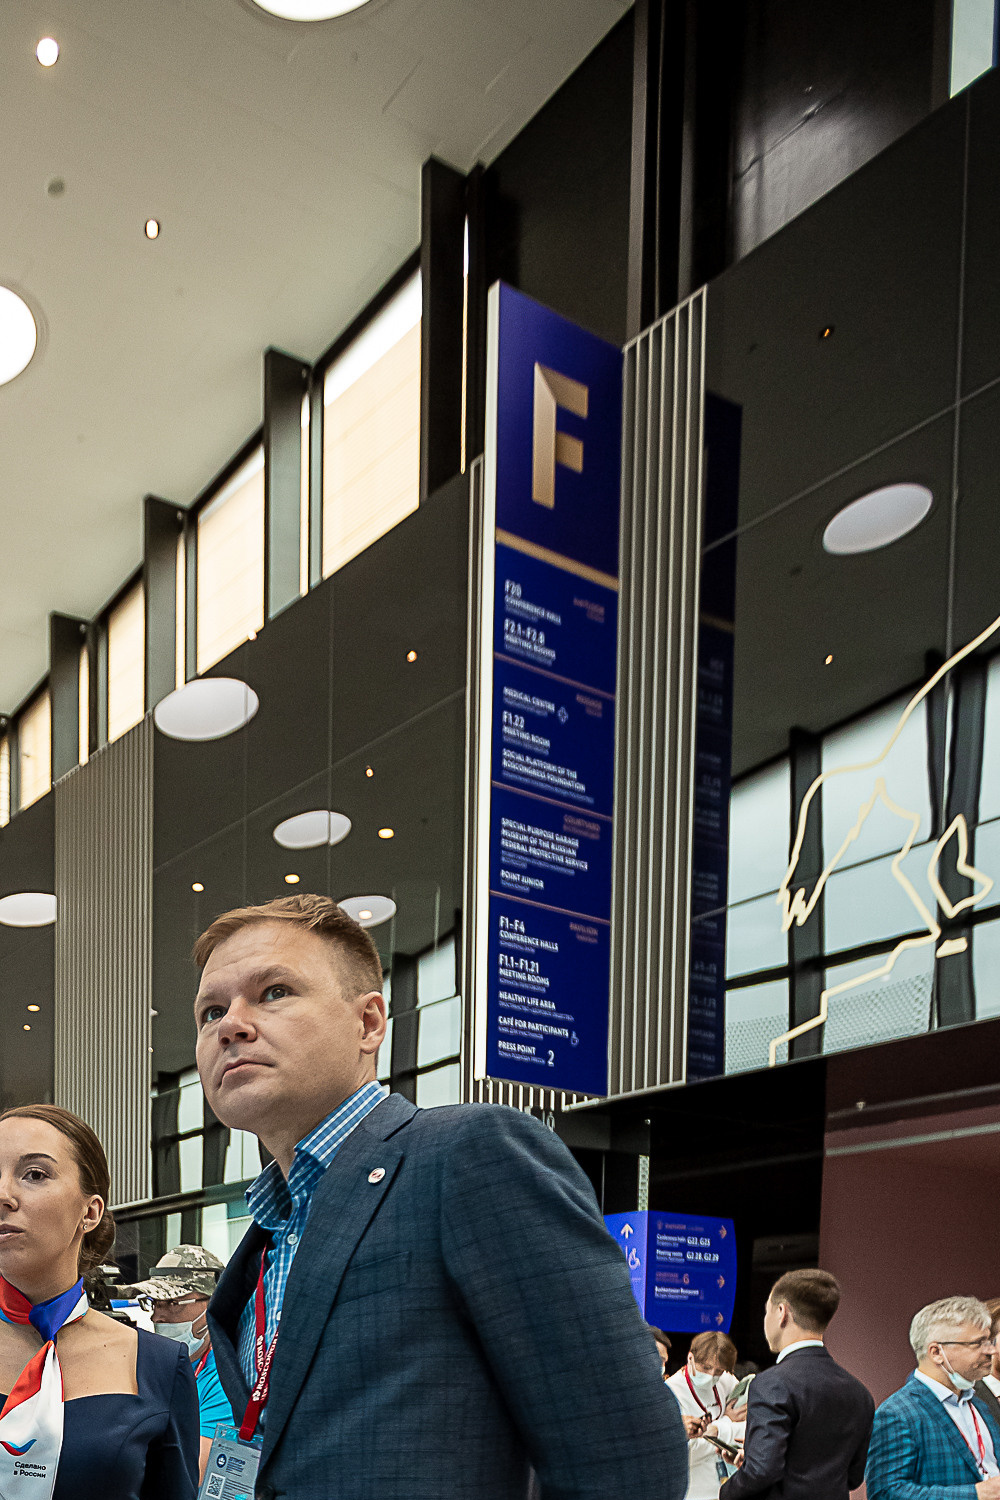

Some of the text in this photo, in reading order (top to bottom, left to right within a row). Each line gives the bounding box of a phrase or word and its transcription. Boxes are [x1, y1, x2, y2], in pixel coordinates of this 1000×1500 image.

[532, 361, 588, 509] F
[501, 817, 526, 831] SPECIAL
[527, 824, 555, 840] PURPOSE
[555, 833, 579, 849] GARAGE
[501, 827, 529, 842] MUSEUM
[550, 842, 577, 858] RUSSIAN
[501, 838, 528, 853] FEDERAL
[529, 846, 564, 864] PROTECTIVE
[565, 856, 588, 872] SERVICE
[501, 869, 520, 882] POINT
[521, 876, 544, 890] JUNIOR
[500, 929, 539, 947] CONFERENCE
[540, 939, 559, 953] HALLS
[499, 967, 526, 981] MEETING
[527, 973, 549, 987] ROOMS
[499, 990, 526, 1003] HEALTHY
[527, 996, 539, 1007] LIFE
[539, 999, 556, 1011] AREA
[514, 1018, 527, 1029] FOR
[527, 1021, 569, 1038] PARTICIPANTS
[498, 1040, 536, 1056] PRESS POINT
[547, 1049, 555, 1067] 2
[14, 1461, 47, 1471] Сделано
[19, 1469, 47, 1478] России
